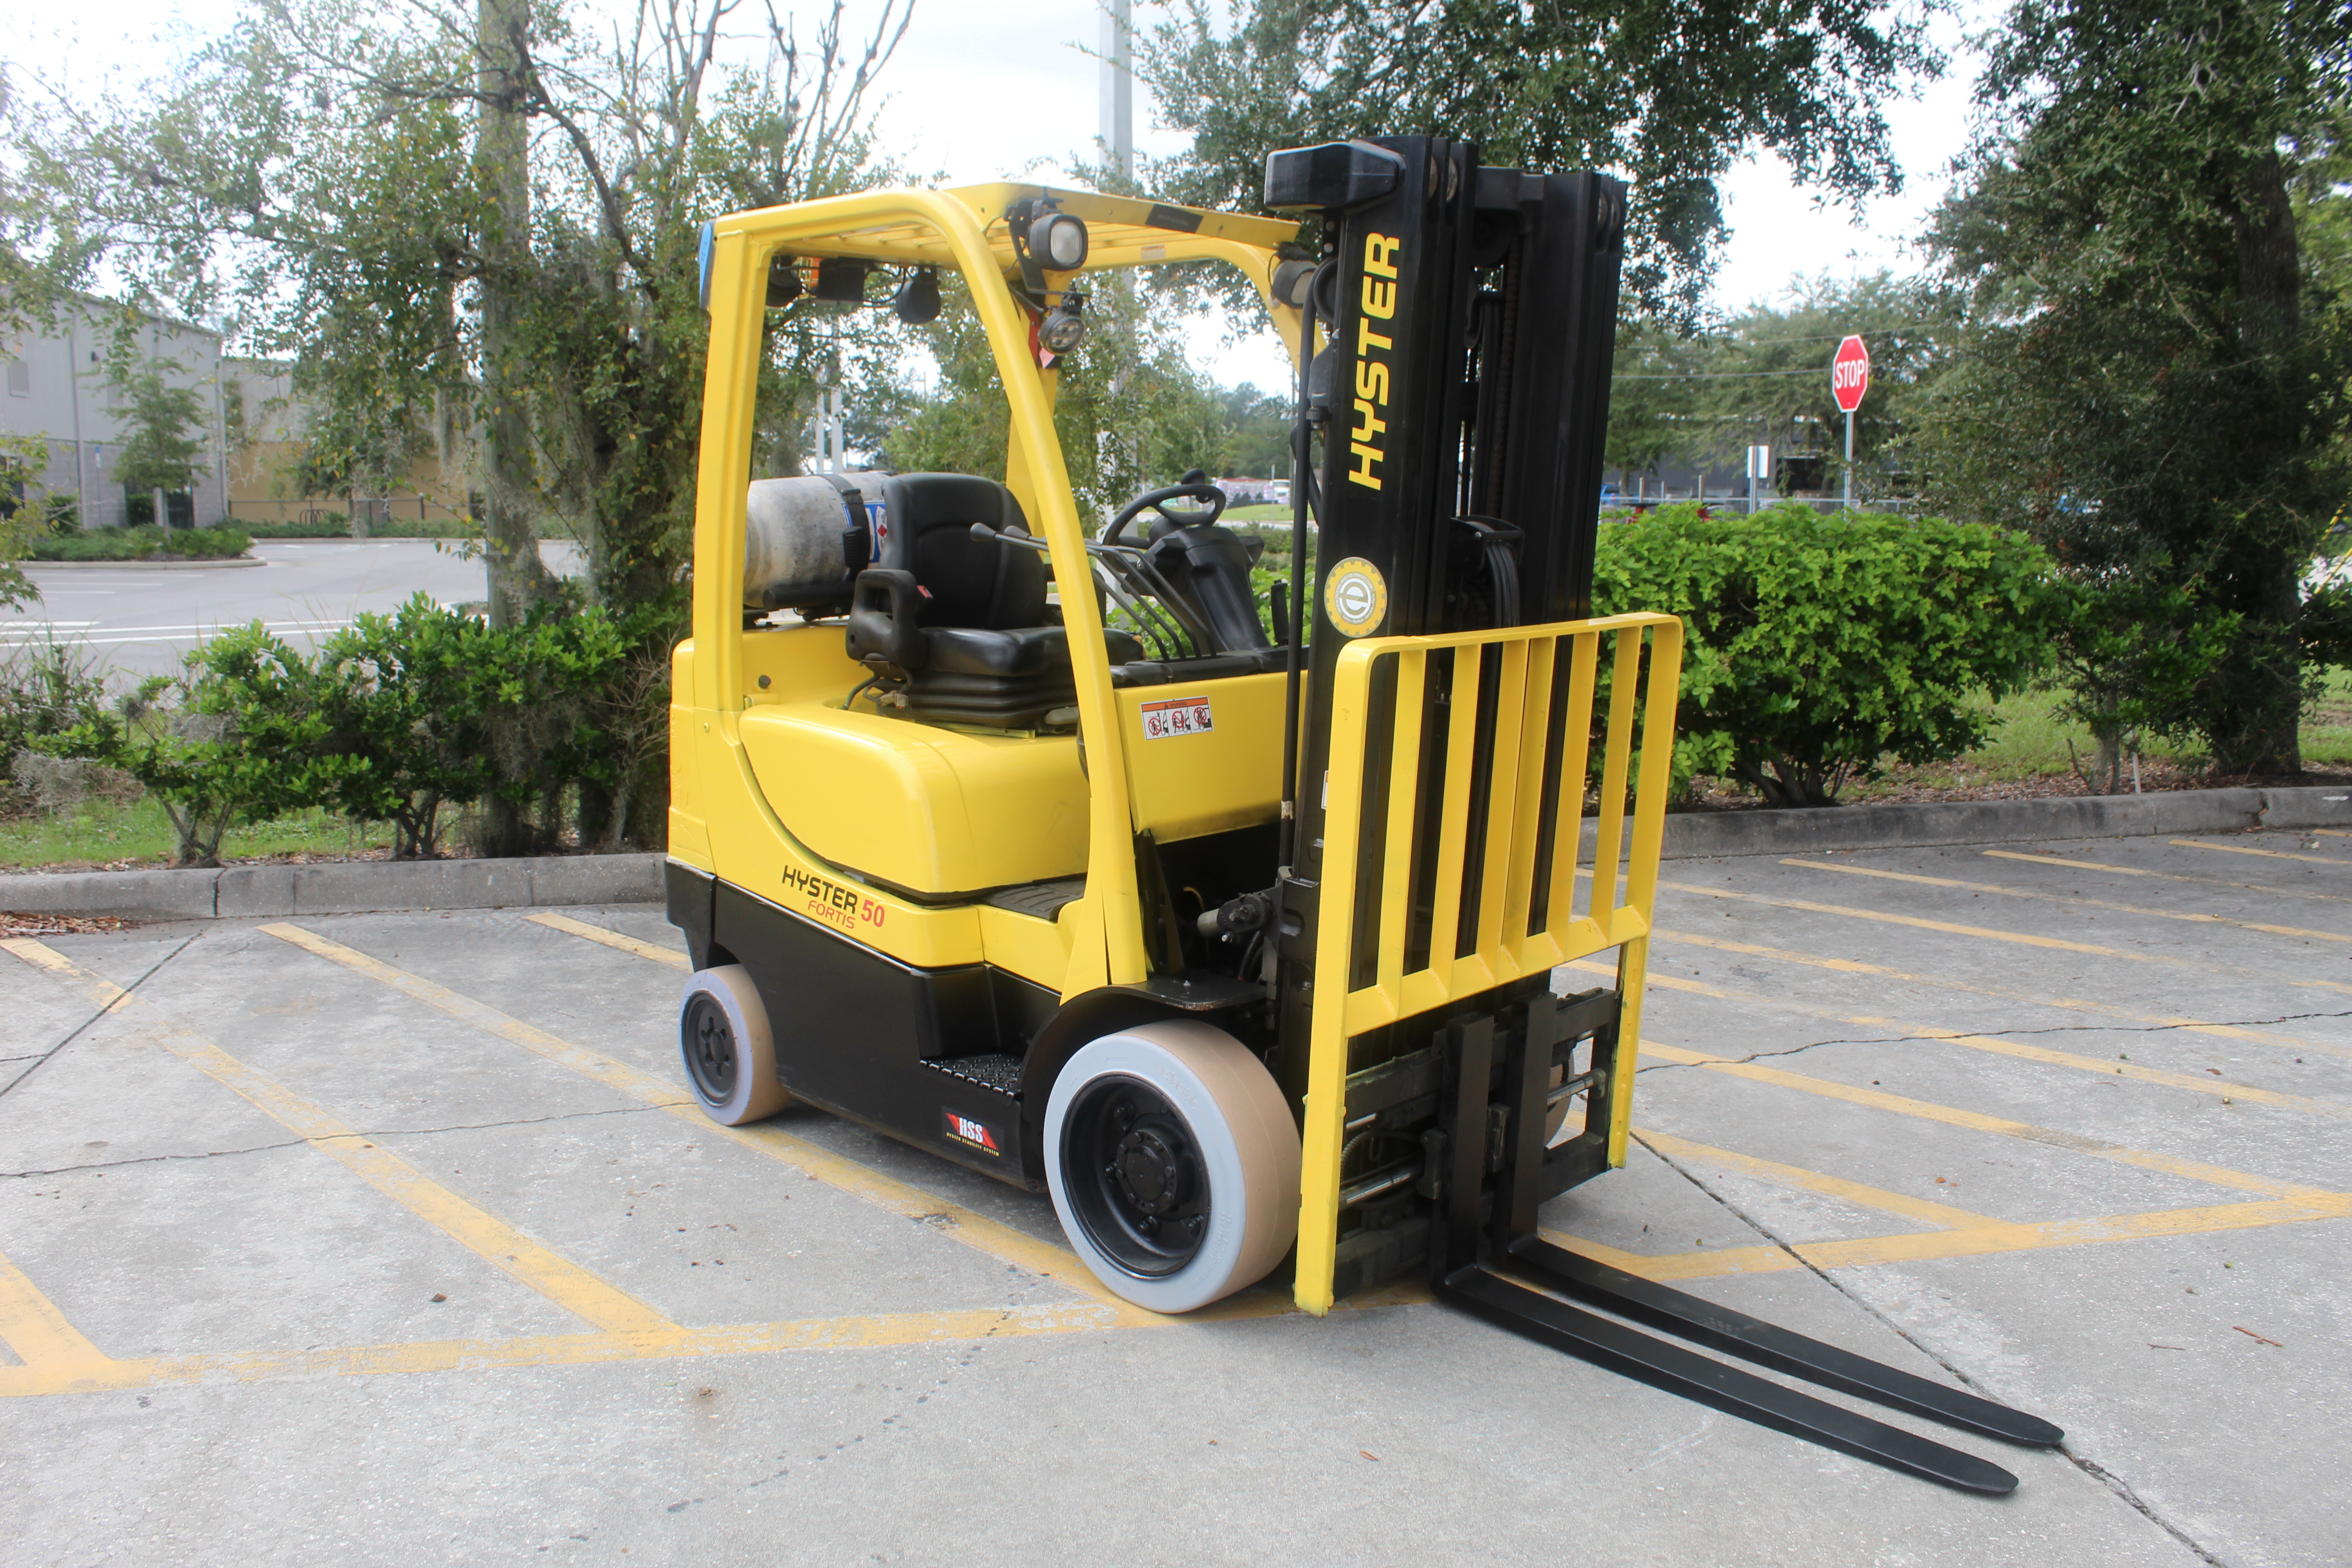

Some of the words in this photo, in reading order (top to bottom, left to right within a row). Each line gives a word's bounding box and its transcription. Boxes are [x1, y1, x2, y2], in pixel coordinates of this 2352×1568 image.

[1348, 232, 1400, 491] HYSTER
[1835, 358, 1865, 389] STOP
[781, 864, 858, 914] HYSTER
[861, 899, 885, 927] 50
[807, 900, 856, 929] FORTIS
[959, 1117, 984, 1143] HSS
